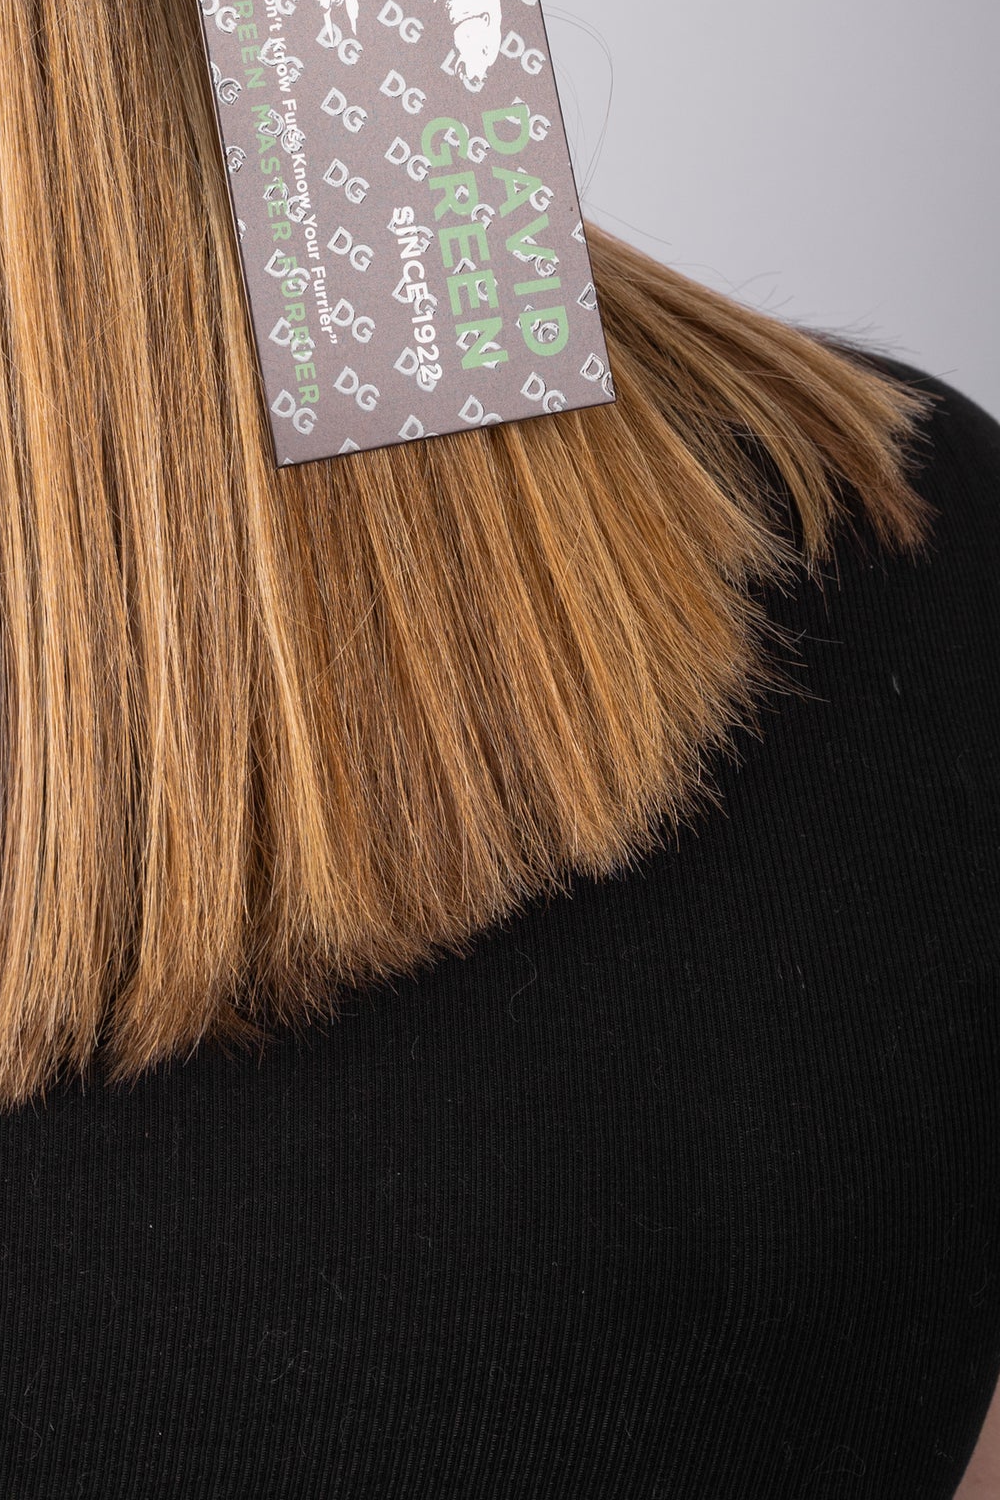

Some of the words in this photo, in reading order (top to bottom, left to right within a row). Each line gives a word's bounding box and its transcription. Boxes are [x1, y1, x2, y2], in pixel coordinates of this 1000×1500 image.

[315, 23, 363, 66] DG
[377, 0, 424, 44] DG
[273, 37, 291, 93] Know
[499, 30, 546, 75] DG
[320, 87, 369, 133] DG
[379, 69, 427, 115] DG
[292, 153, 311, 209] Know
[323, 157, 371, 205] DG
[384, 136, 432, 181] DG
[303, 214, 320, 260] Your
[327, 226, 375, 272] DG
[421, 117, 508, 369] GREEN
[481, 105, 569, 356] DAVID
[251, 104, 292, 242] MASTER
[278, 256, 320, 405] FURRIER
[264, 248, 311, 295] DG
[311, 265, 338, 345] Furrier”
[393, 206, 428, 301] SINCE
[412, 311, 442, 382] 1922
[268, 317, 317, 362] DG
[330, 298, 376, 343] DG
[271, 389, 318, 435] DG
[333, 366, 381, 412] DG
[520, 371, 568, 414] DG
